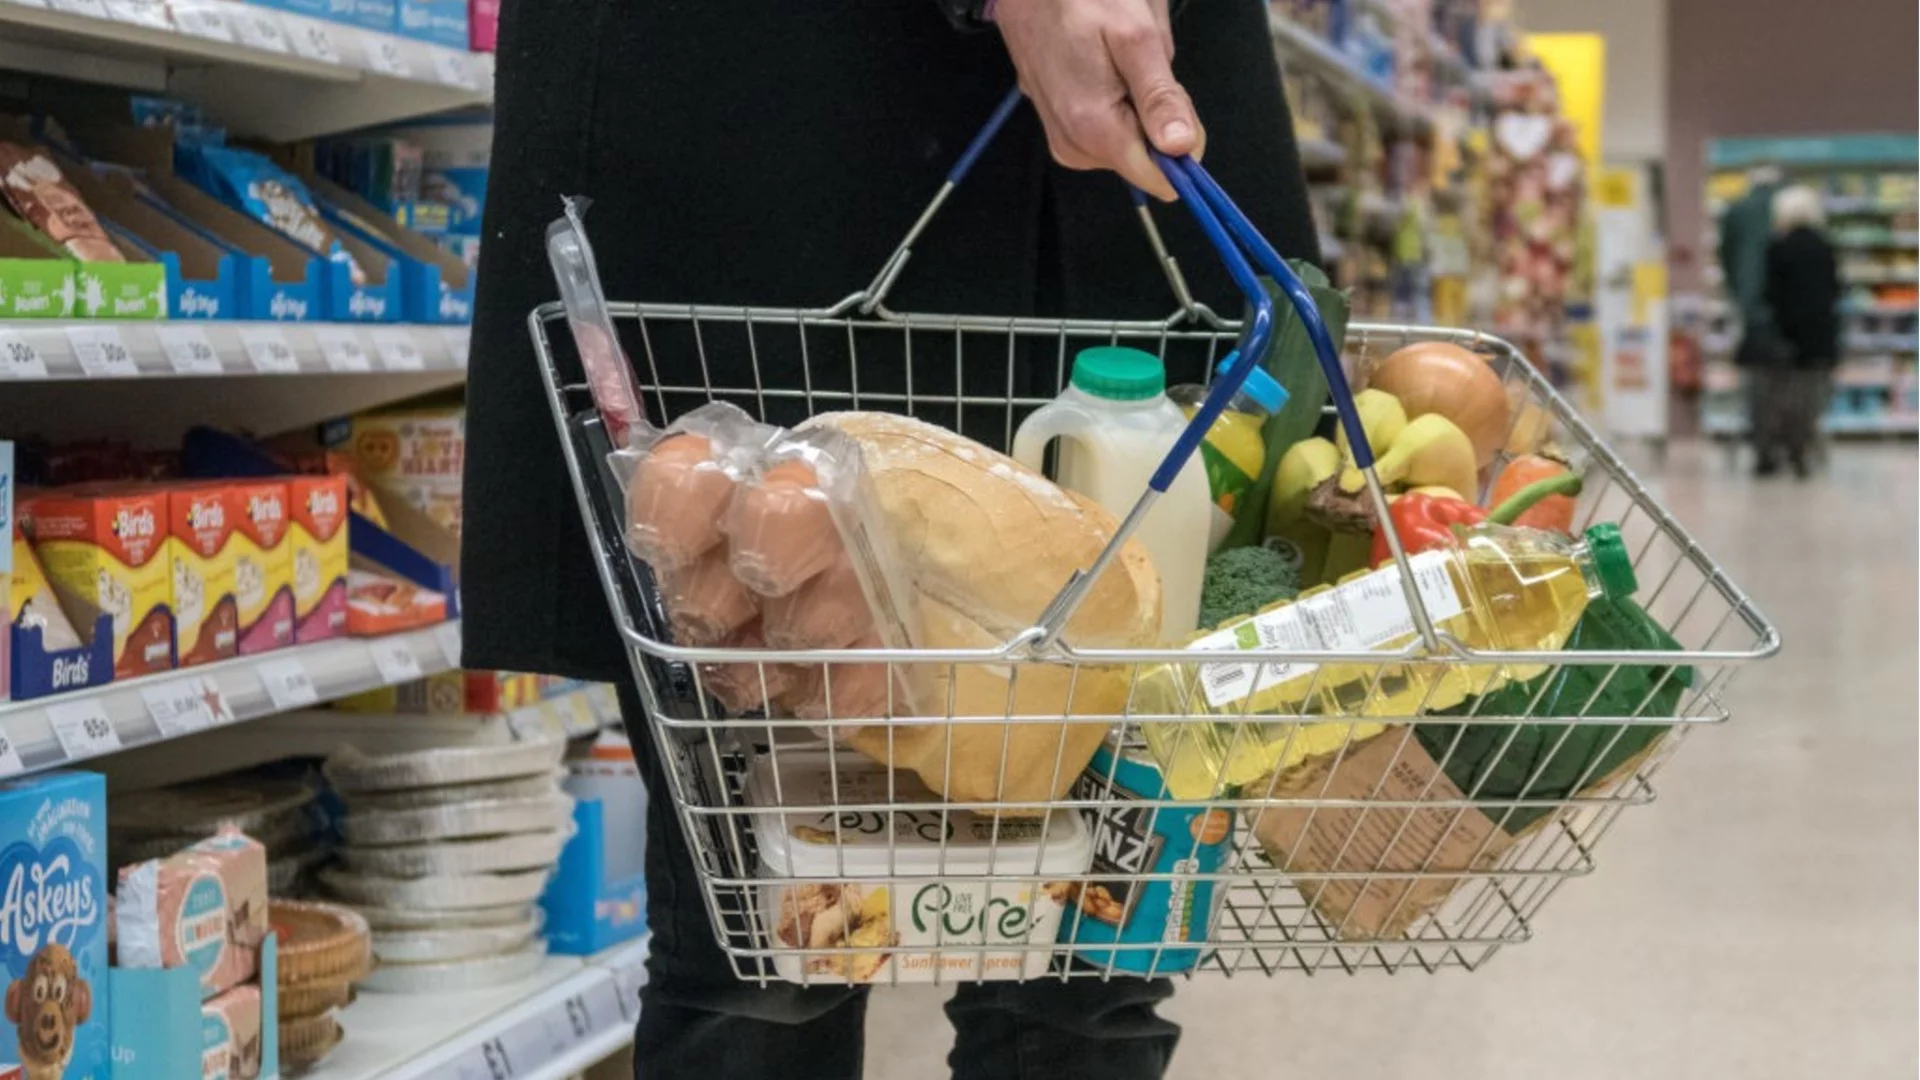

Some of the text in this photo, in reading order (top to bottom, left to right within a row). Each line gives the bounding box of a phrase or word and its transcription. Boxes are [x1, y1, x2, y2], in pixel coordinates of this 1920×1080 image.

[0, 854, 97, 956] Askeys
[912, 883, 1031, 938] Pure
[981, 956, 1022, 971] prea
[111, 1045, 135, 1064] Up
